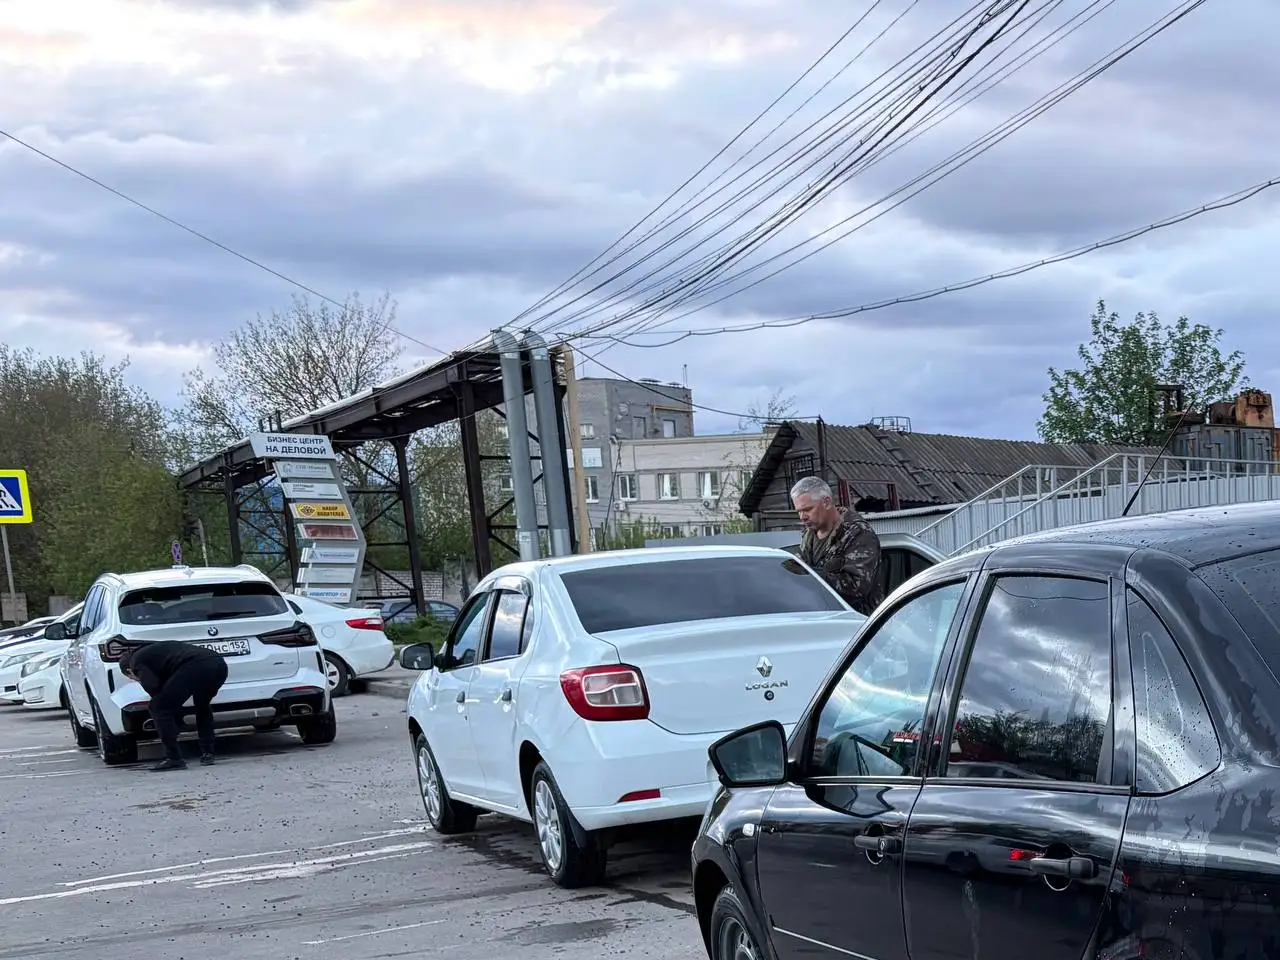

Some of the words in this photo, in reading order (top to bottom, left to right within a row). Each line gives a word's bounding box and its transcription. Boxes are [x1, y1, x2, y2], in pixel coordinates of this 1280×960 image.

[267, 436, 297, 444] БИЗНЕС
[265, 445, 279, 453] НА
[281, 445, 327, 455] ДЕЛОВОЙ
[229, 641, 246, 650] 152
[745, 680, 788, 690] LOGAN
